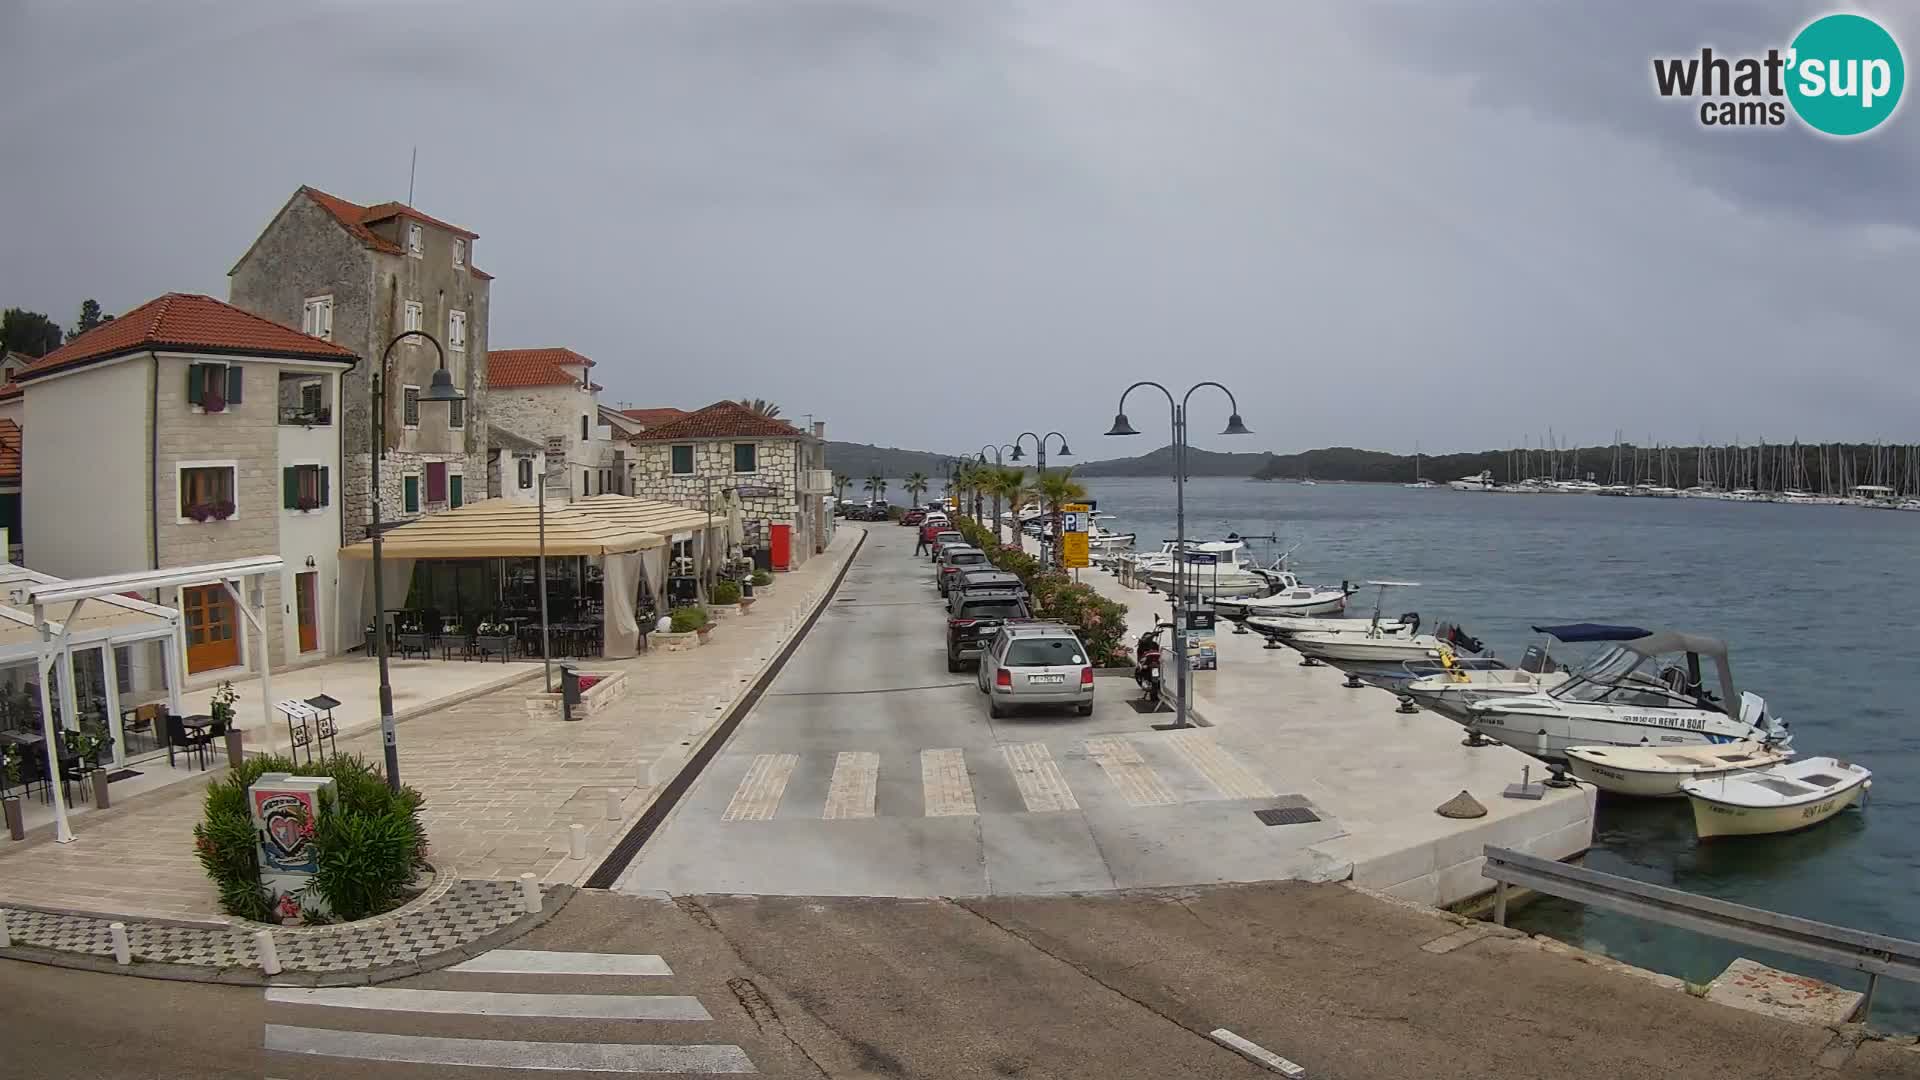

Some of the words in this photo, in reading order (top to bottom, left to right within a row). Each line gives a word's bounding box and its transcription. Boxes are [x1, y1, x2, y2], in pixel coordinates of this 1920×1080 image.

[1065, 514, 1076, 531] P
[1658, 717, 1680, 727] RENT
[1680, 719, 1686, 728] A
[1686, 719, 1706, 730] BOAT
